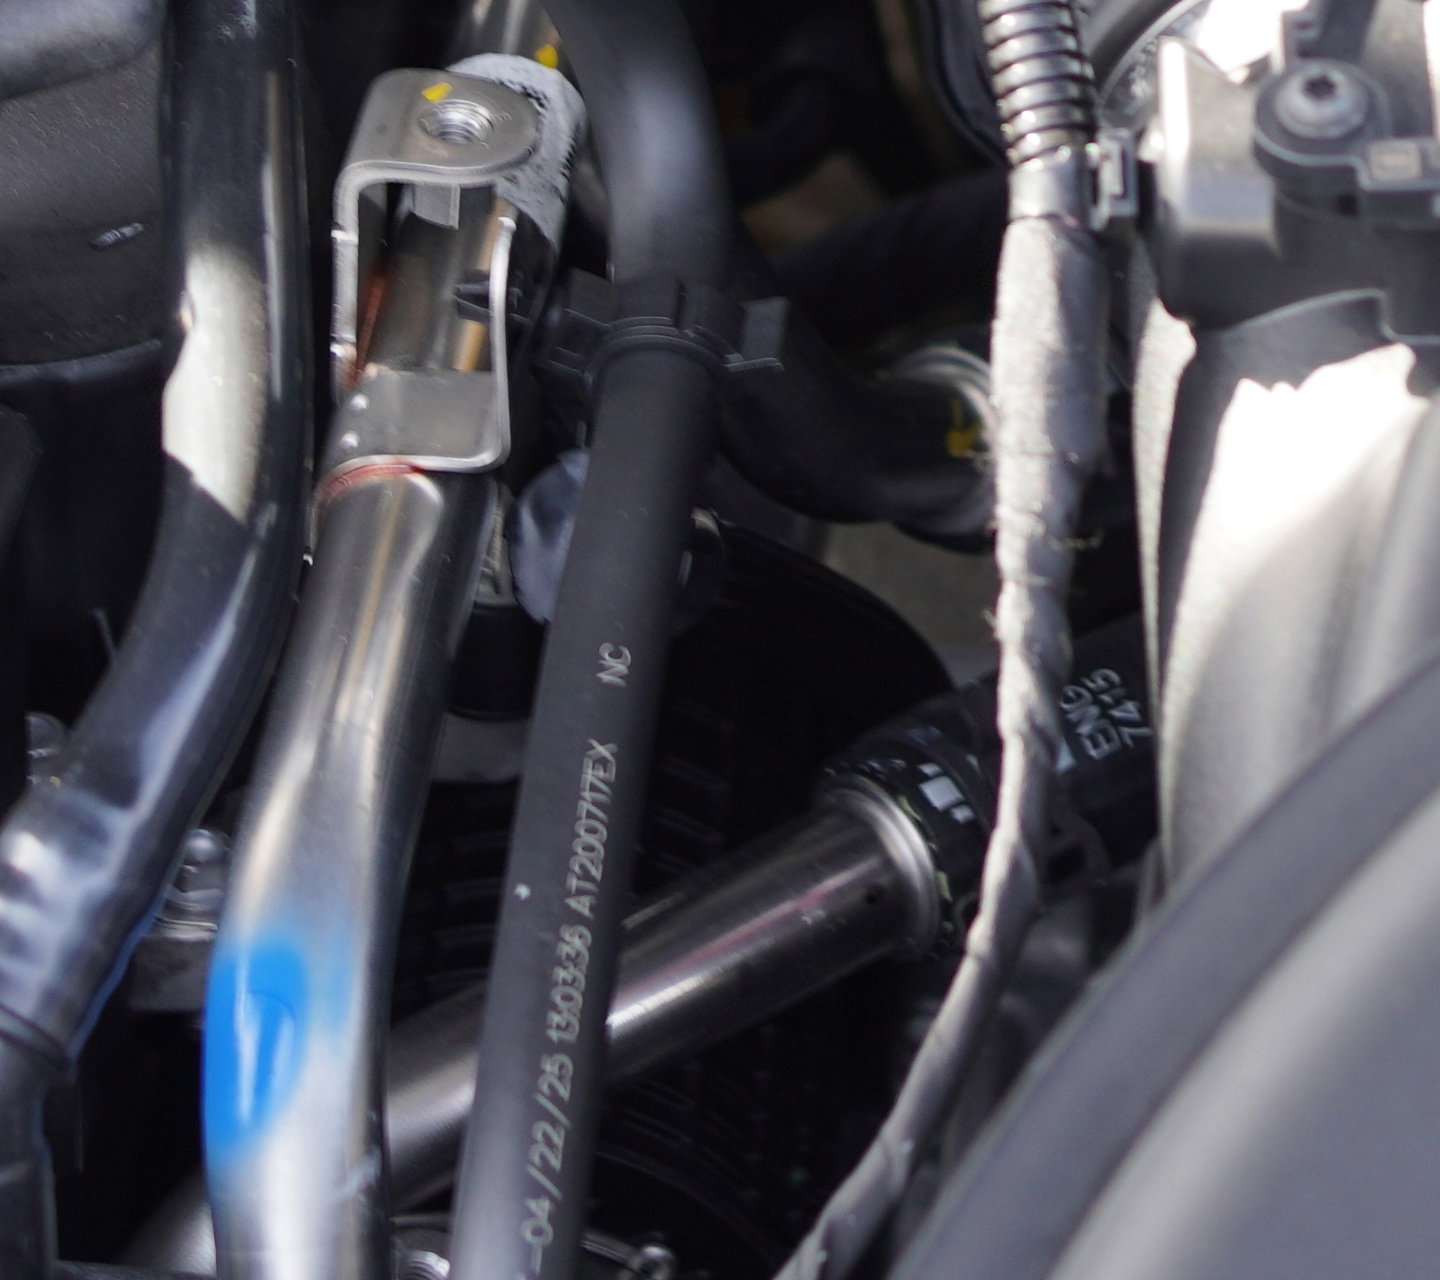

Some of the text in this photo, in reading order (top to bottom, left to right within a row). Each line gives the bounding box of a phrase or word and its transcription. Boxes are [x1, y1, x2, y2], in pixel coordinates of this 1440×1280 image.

[1060, 685, 1122, 760] ENG
[1081, 667, 1154, 748] 7415
[565, 738, 617, 919] AT200717EX
[596, 642, 633, 687] NC
